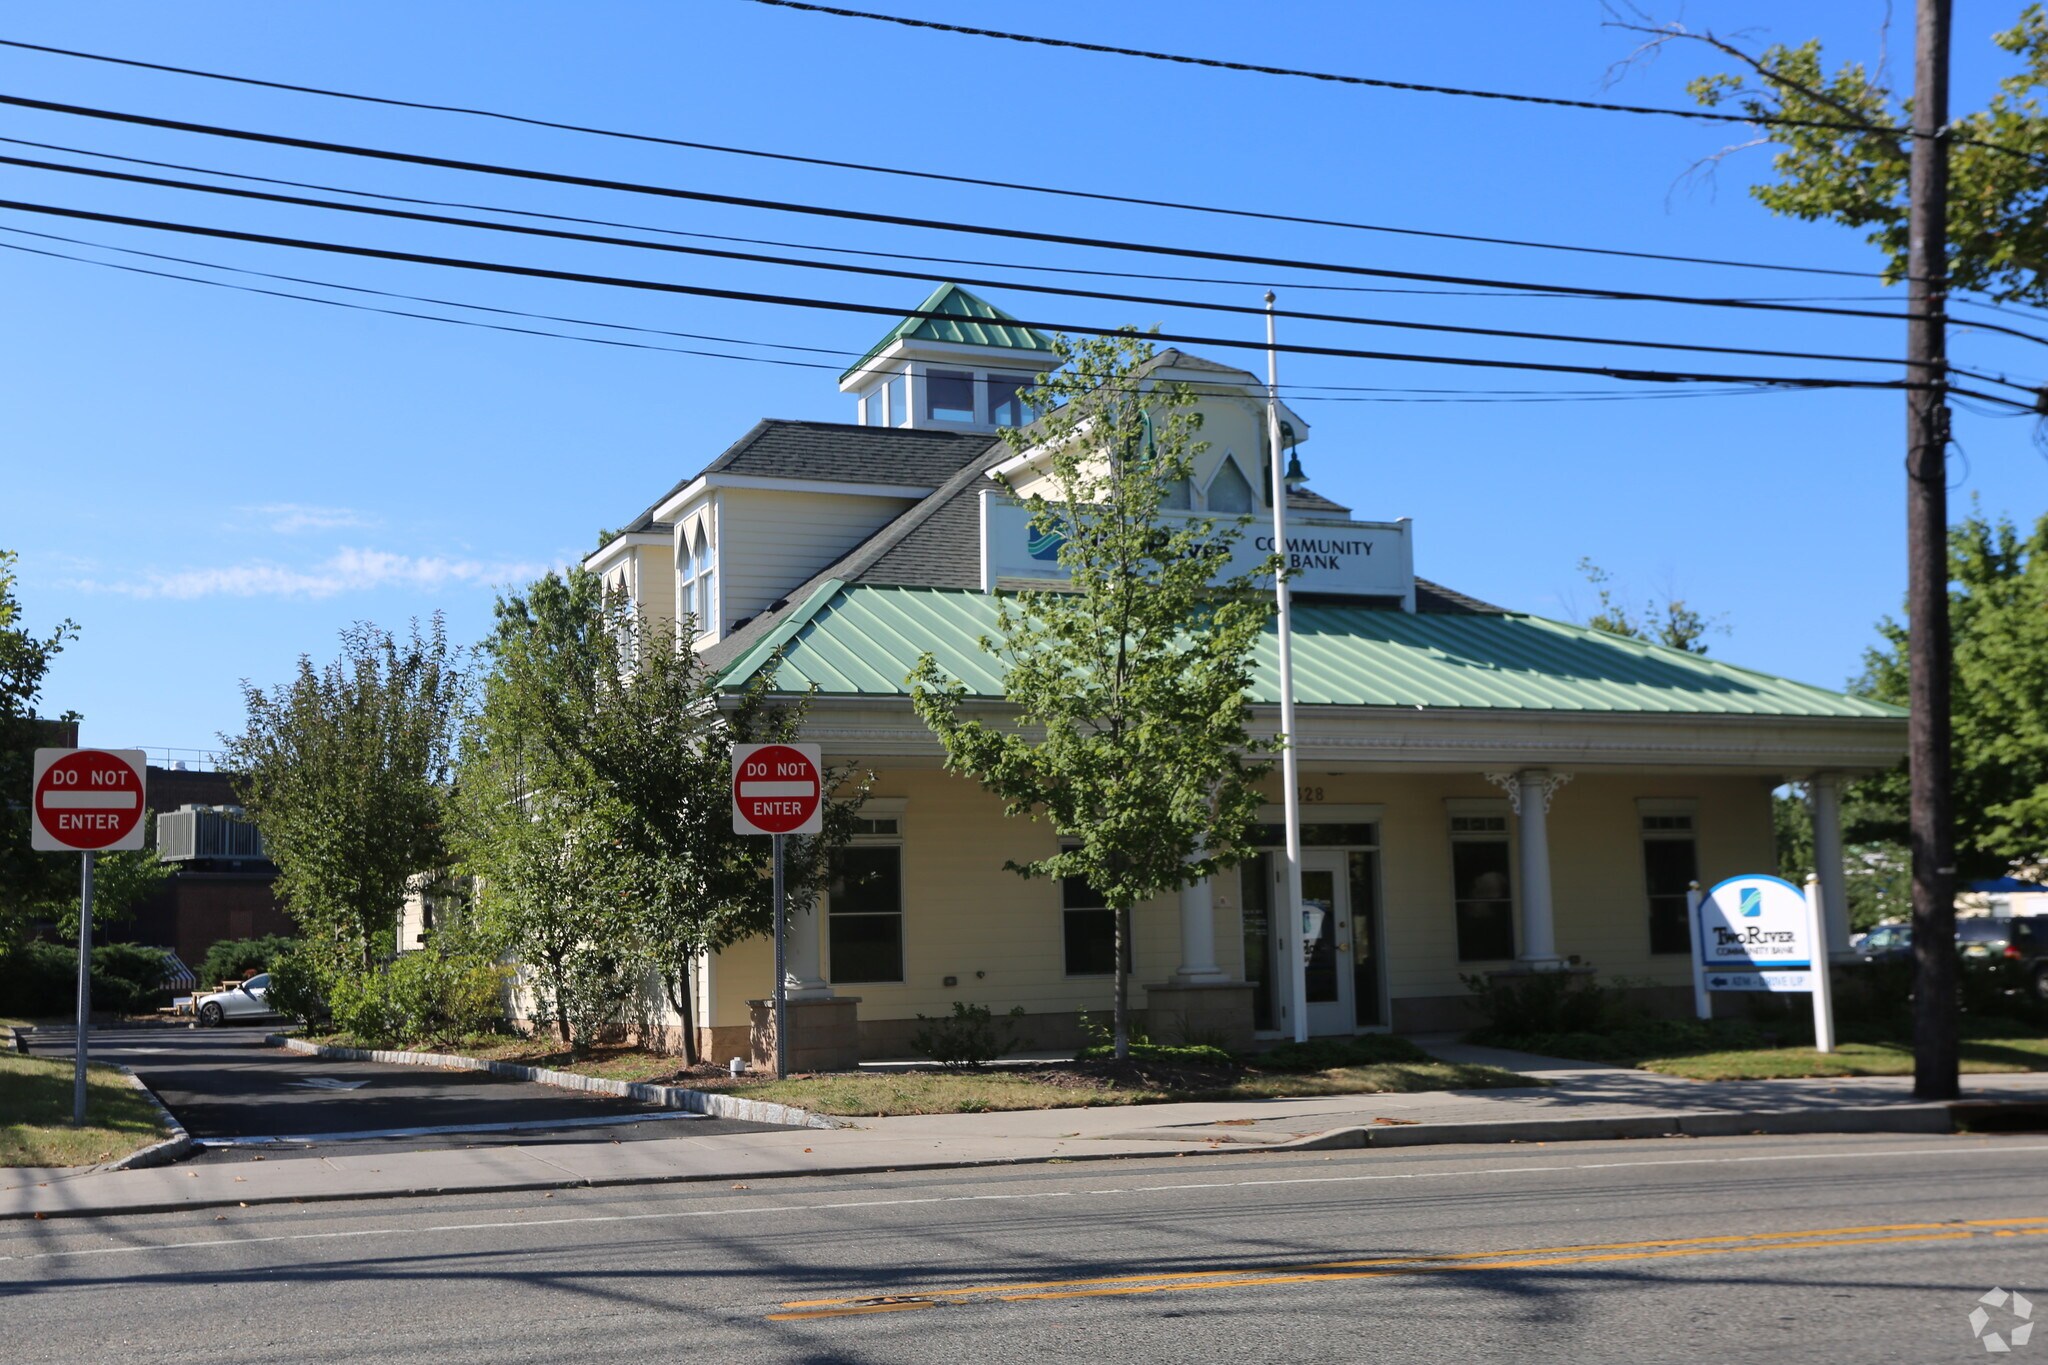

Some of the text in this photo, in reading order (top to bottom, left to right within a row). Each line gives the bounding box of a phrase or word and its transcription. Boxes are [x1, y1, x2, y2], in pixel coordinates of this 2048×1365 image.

[1291, 554, 1340, 570] BANK
[747, 763, 806, 776] DO NOT
[53, 770, 128, 785] DO NOT
[753, 802, 801, 816] ENTER
[59, 814, 119, 829] ENTER
